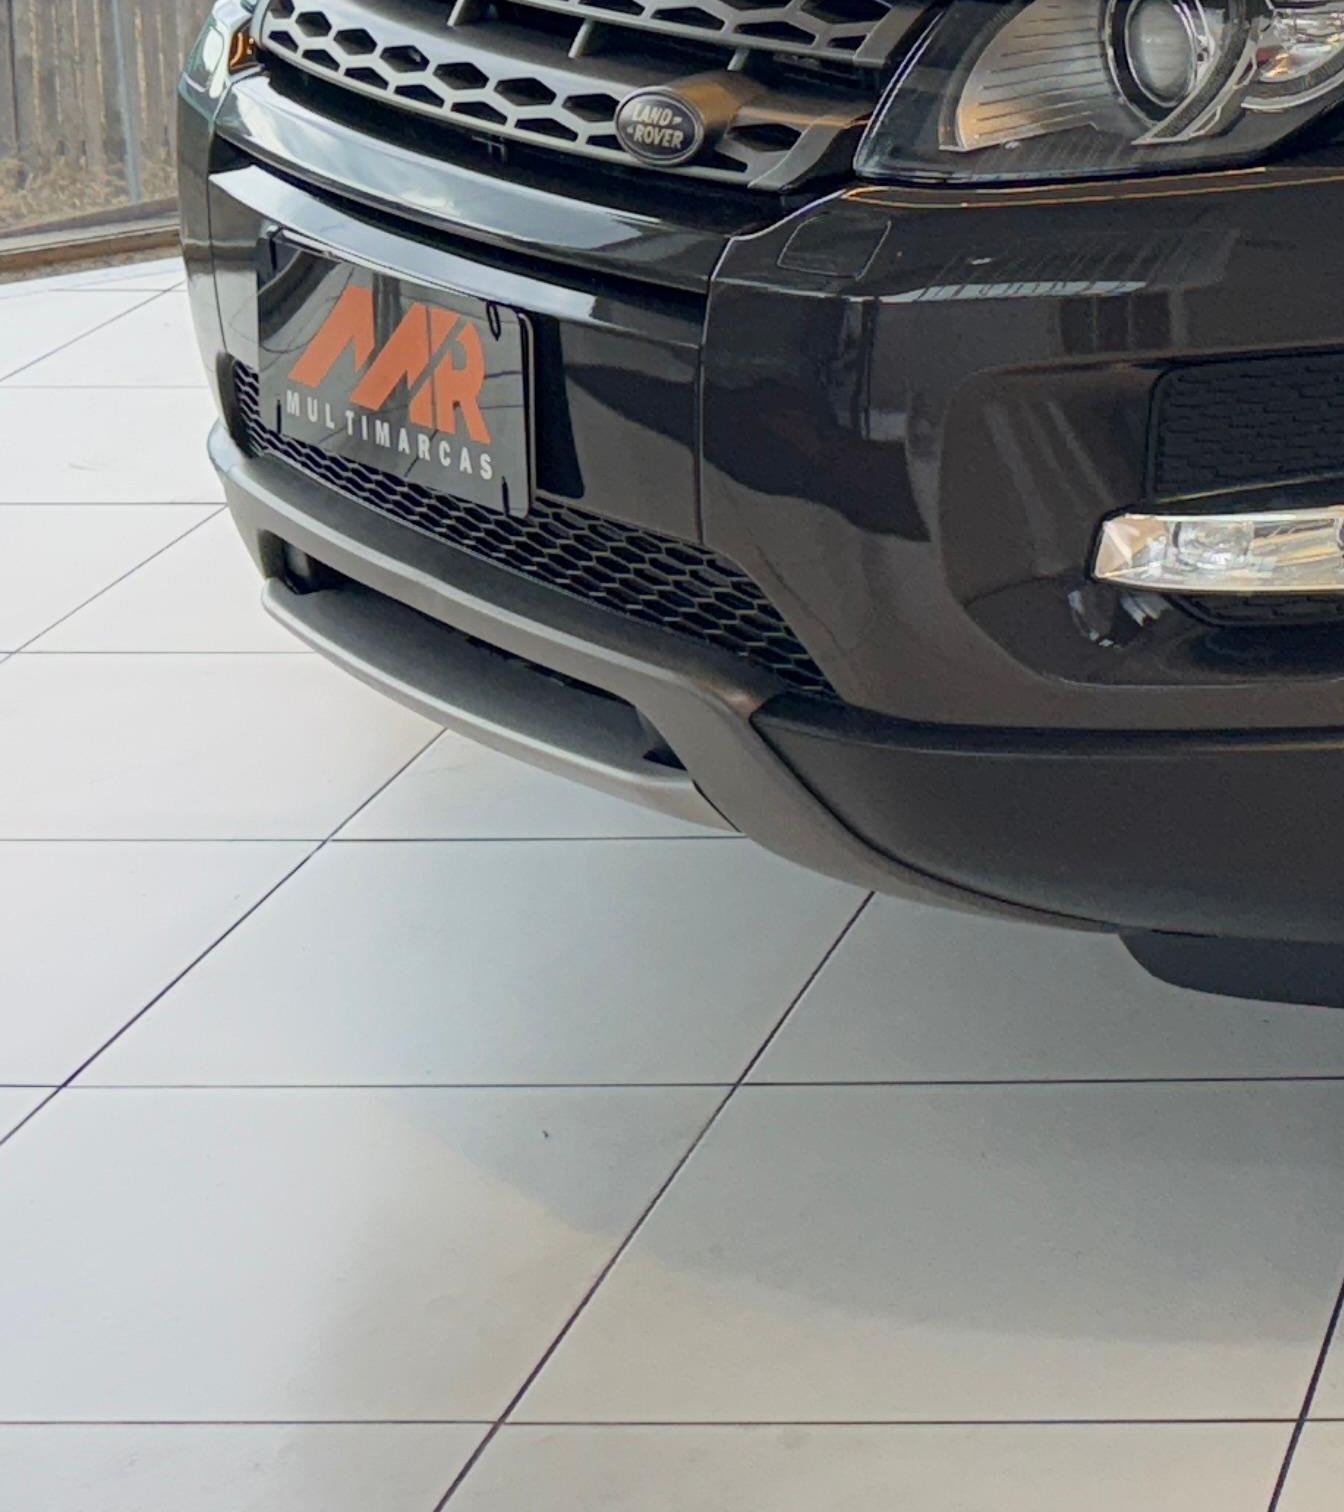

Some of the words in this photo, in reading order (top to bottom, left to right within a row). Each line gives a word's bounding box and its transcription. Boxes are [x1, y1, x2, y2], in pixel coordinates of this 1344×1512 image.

[632, 103, 673, 126] LAND
[635, 125, 684, 149] ROVER
[286, 390, 493, 480] MULTIMARCAS
